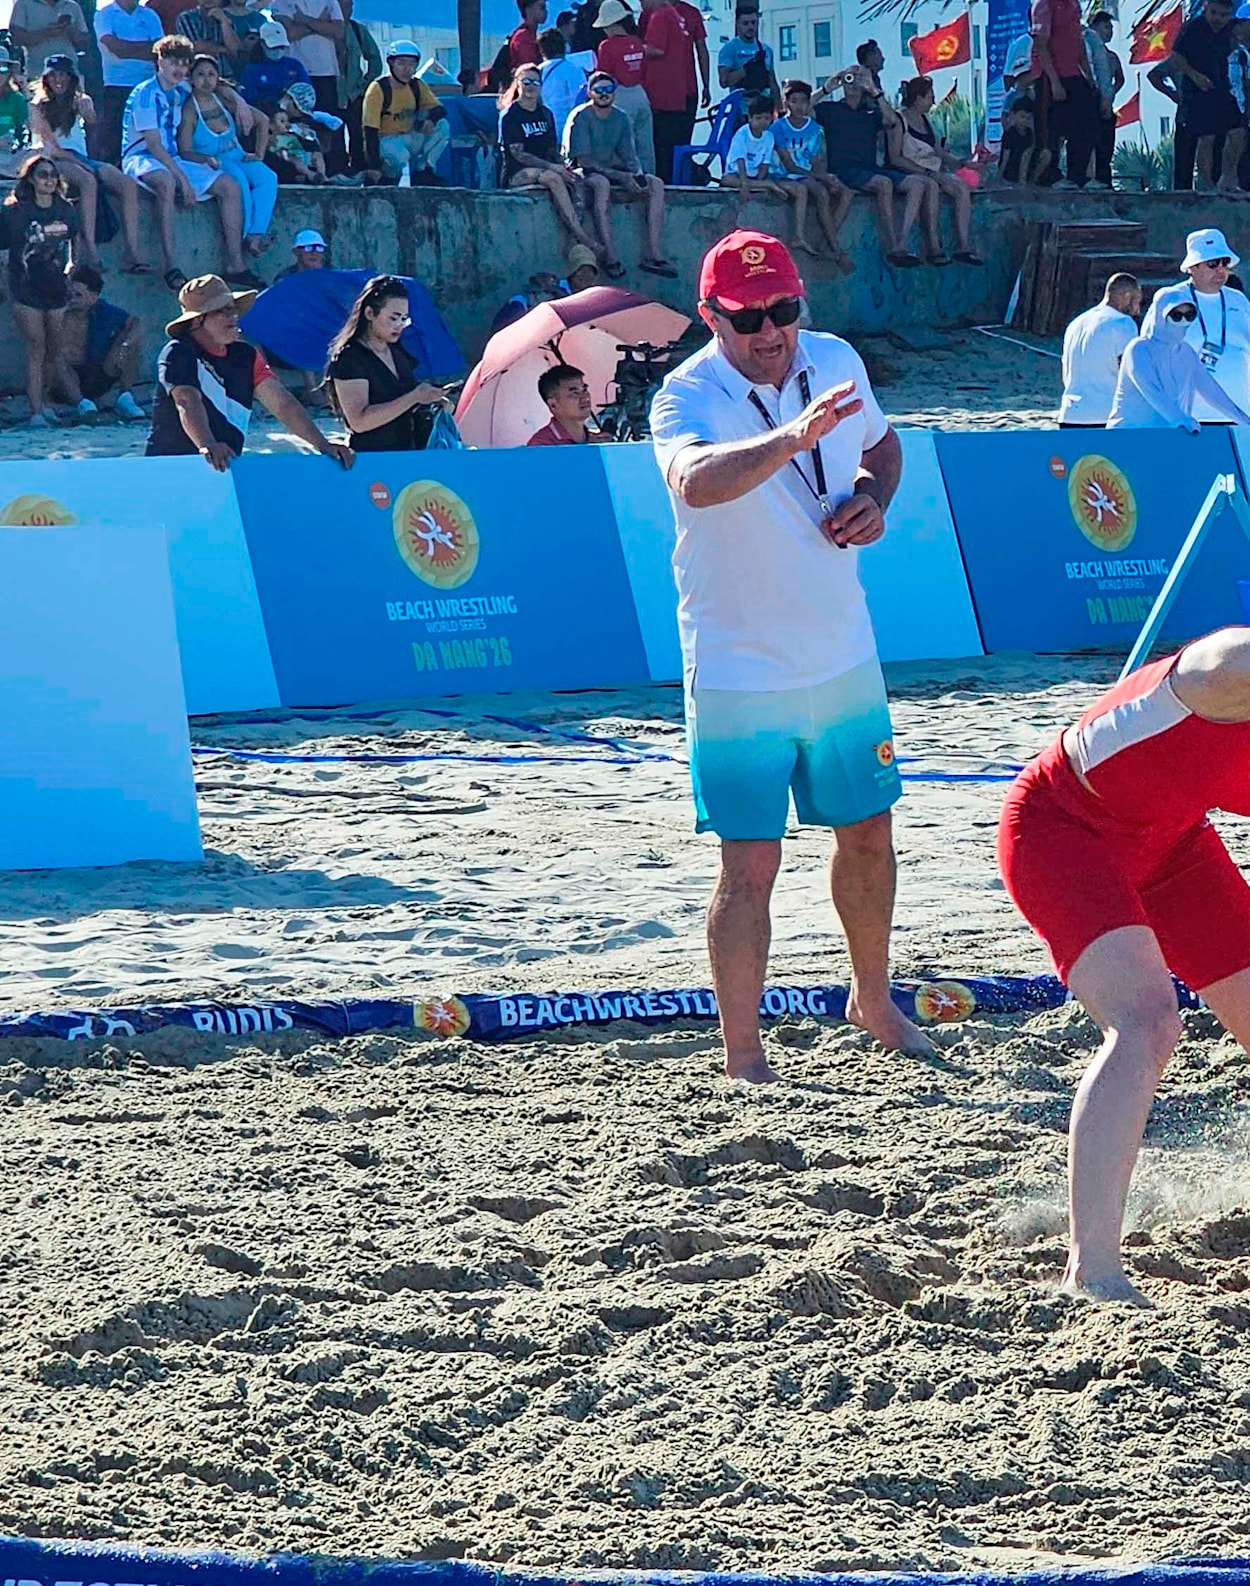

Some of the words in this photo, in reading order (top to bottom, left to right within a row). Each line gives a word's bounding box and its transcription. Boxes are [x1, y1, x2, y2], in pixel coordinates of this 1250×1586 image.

[1065, 561, 1103, 579] BEACH
[1104, 559, 1169, 576] WRESTLING
[386, 601, 435, 621] BEACH
[438, 596, 518, 618] WRESTLING
[1086, 598, 1108, 624] DA
[425, 620, 458, 633] WORLD
[460, 618, 487, 632] SERIES
[412, 640, 439, 671] DA
[439, 636, 512, 670] NANG'26
[192, 1007, 293, 1034] RUDIS
[500, 989, 826, 1027] BEACHWRESTLI.ORG
